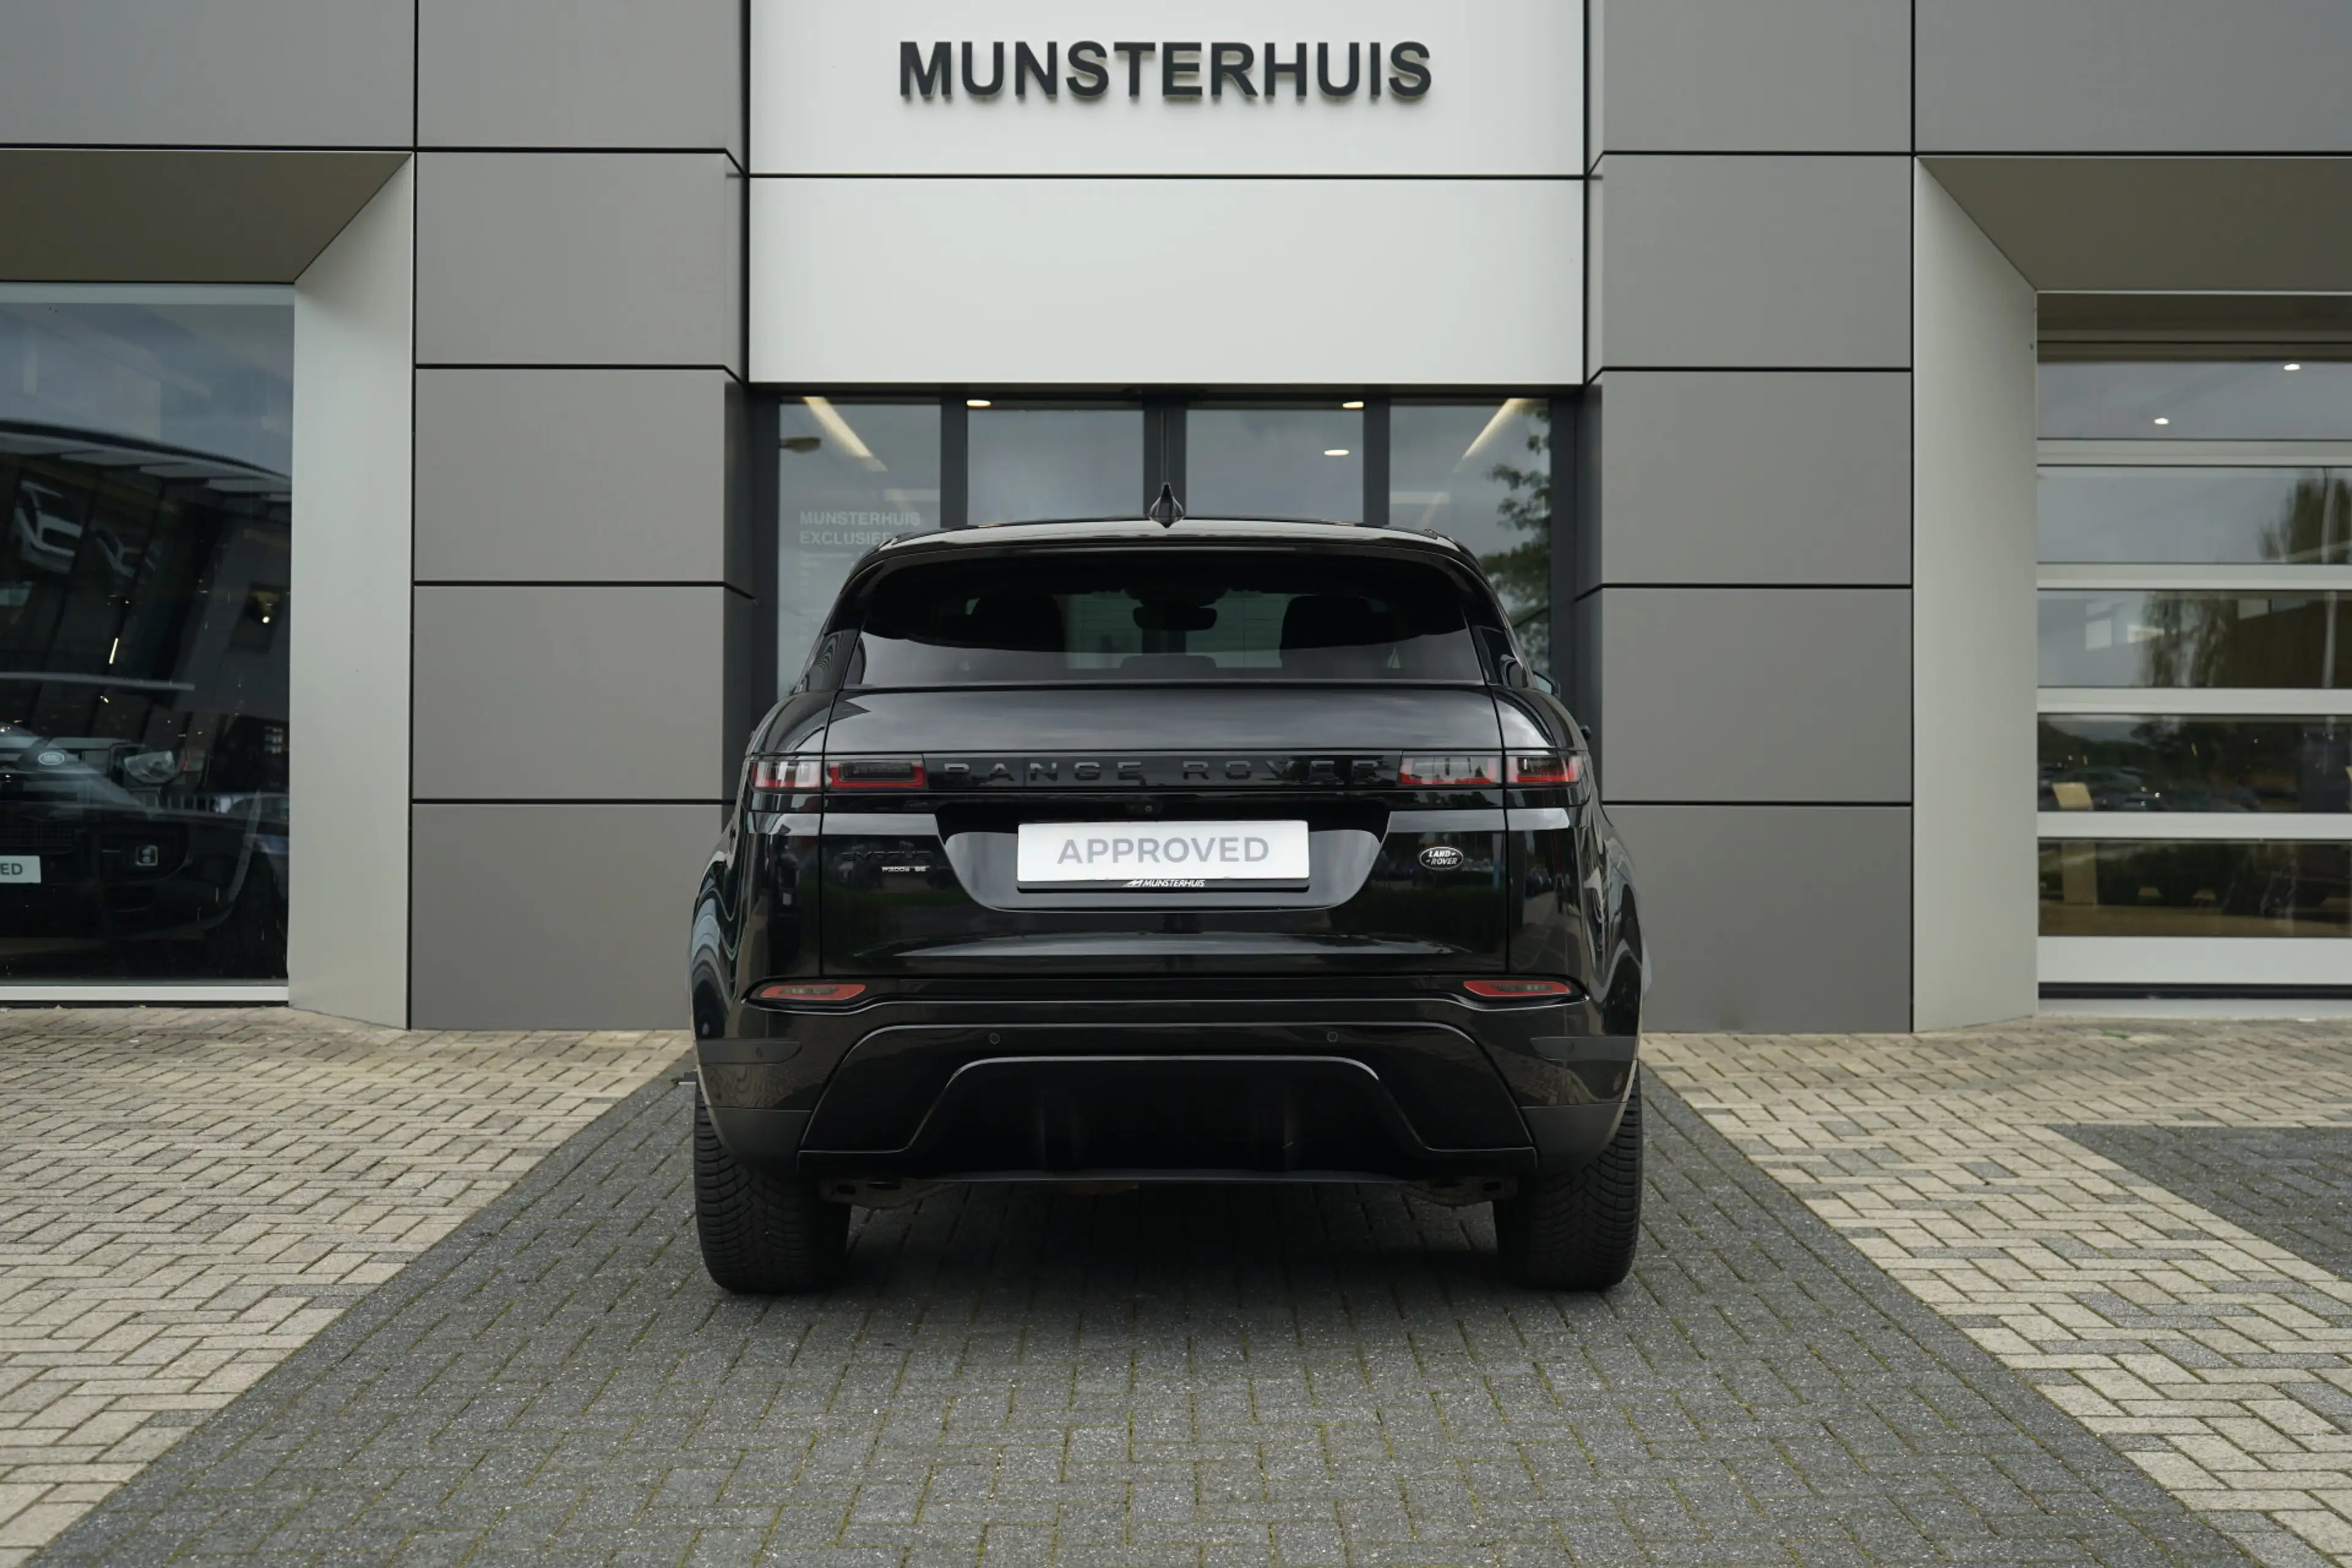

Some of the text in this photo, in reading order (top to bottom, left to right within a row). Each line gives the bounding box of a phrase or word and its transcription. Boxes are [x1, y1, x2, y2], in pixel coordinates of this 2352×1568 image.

[899, 40, 1432, 98] MUNSTERHUIS
[799, 510, 921, 526] MUNSTERHUIS
[944, 760, 1379, 784] RANGE ROVER
[1057, 837, 1269, 864] APPROVED
[1142, 879, 1205, 888] MUNSTERHUIS
